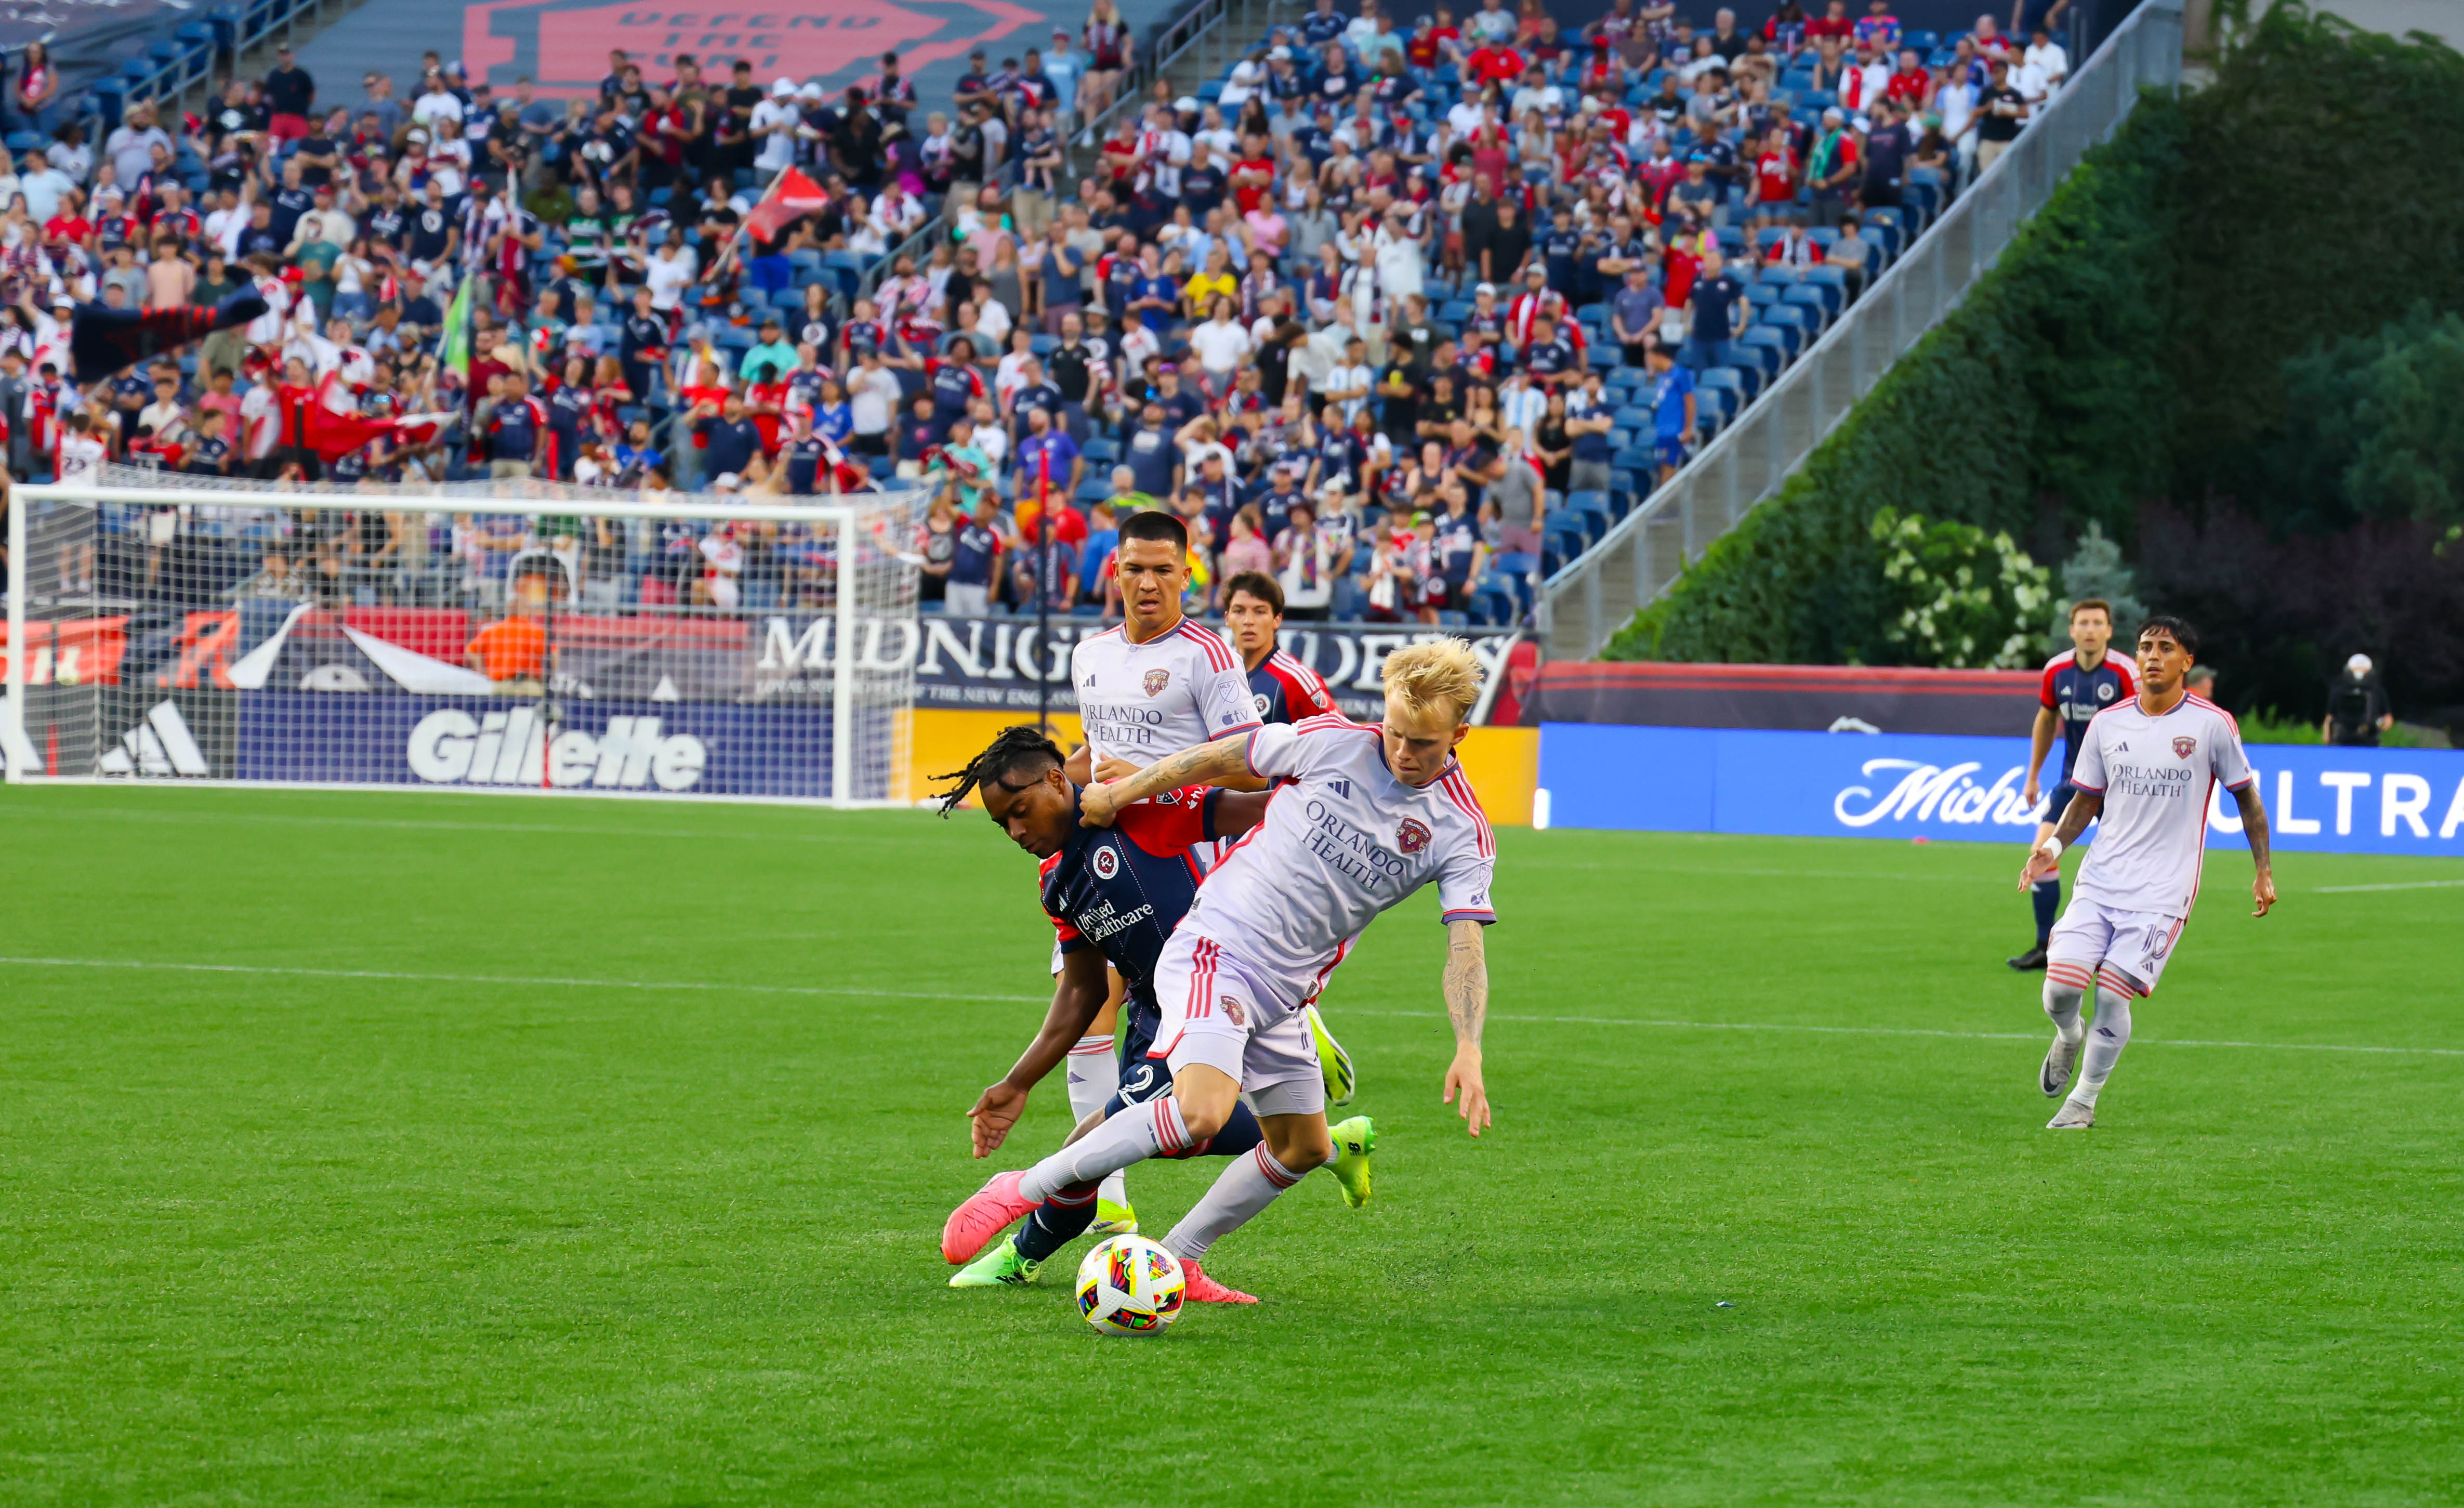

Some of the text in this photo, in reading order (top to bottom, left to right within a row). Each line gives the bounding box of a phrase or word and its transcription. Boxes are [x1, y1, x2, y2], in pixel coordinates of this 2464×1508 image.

[757, 616, 1106, 681] MDNIG
[964, 686, 1005, 703] NEW
[1082, 702, 1163, 725] ORLANDO
[406, 705, 707, 791] Gillette
[1093, 723, 1152, 744] HEALTH
[2113, 763, 2192, 781] ORLANDO
[1833, 757, 2052, 827] Miche
[1306, 801, 1404, 876] ORLANDO
[1078, 899, 1116, 930] United
[2141, 923, 2169, 960] 10
